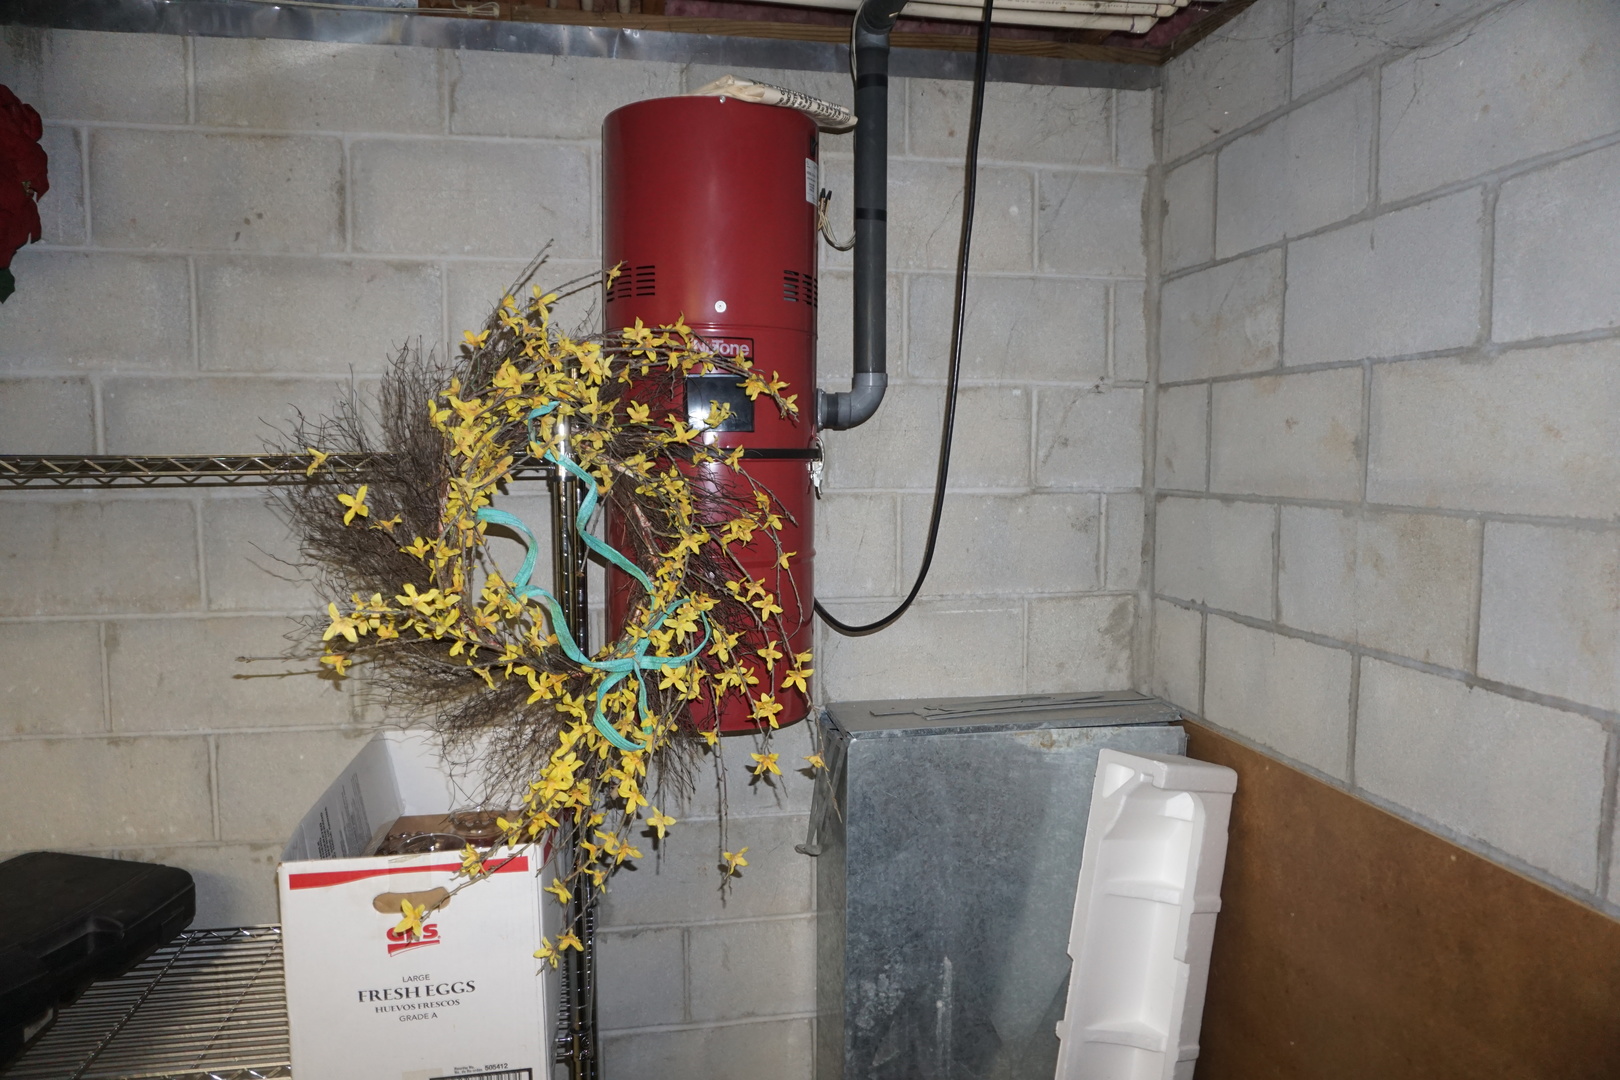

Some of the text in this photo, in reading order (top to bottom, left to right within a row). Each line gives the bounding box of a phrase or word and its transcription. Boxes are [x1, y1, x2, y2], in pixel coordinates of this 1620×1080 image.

[402, 974, 431, 983] LARGE
[358, 980, 476, 1003] FRESH EGGS
[375, 999, 461, 1013] HUEVOS FRESCOS
[399, 1013, 429, 1022] GRADE
[484, 1062, 508, 1071] 505412
